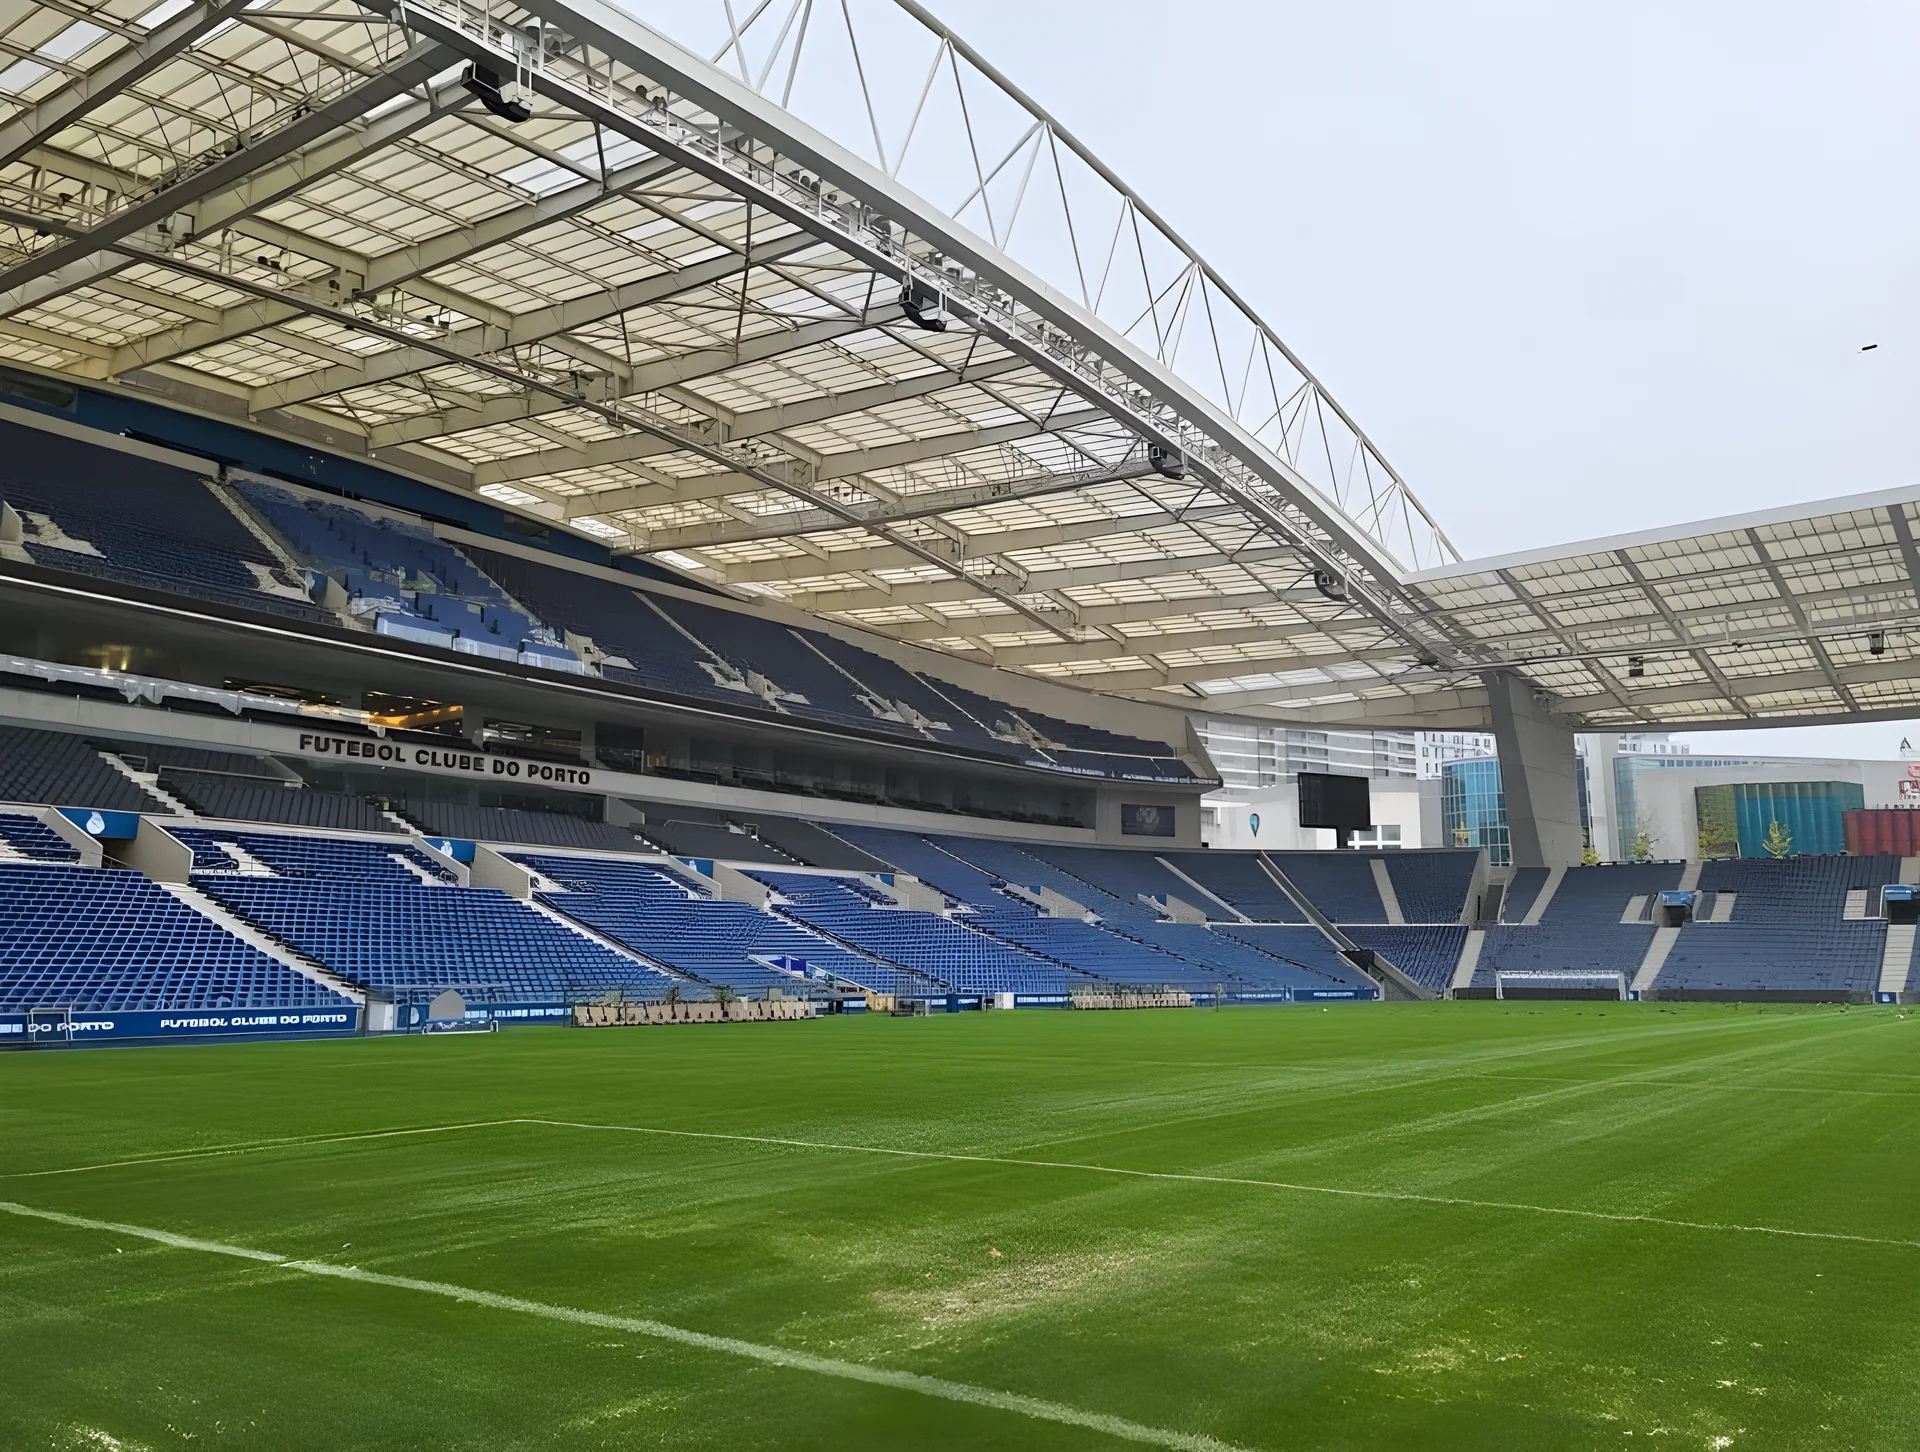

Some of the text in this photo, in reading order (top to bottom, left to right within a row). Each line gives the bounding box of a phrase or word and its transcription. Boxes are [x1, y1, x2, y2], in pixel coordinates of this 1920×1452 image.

[299, 733, 591, 785] FUTEBOL CLUBE DO PORTO
[280, 1015, 300, 1024] DO
[28, 1023, 52, 1033] DO
